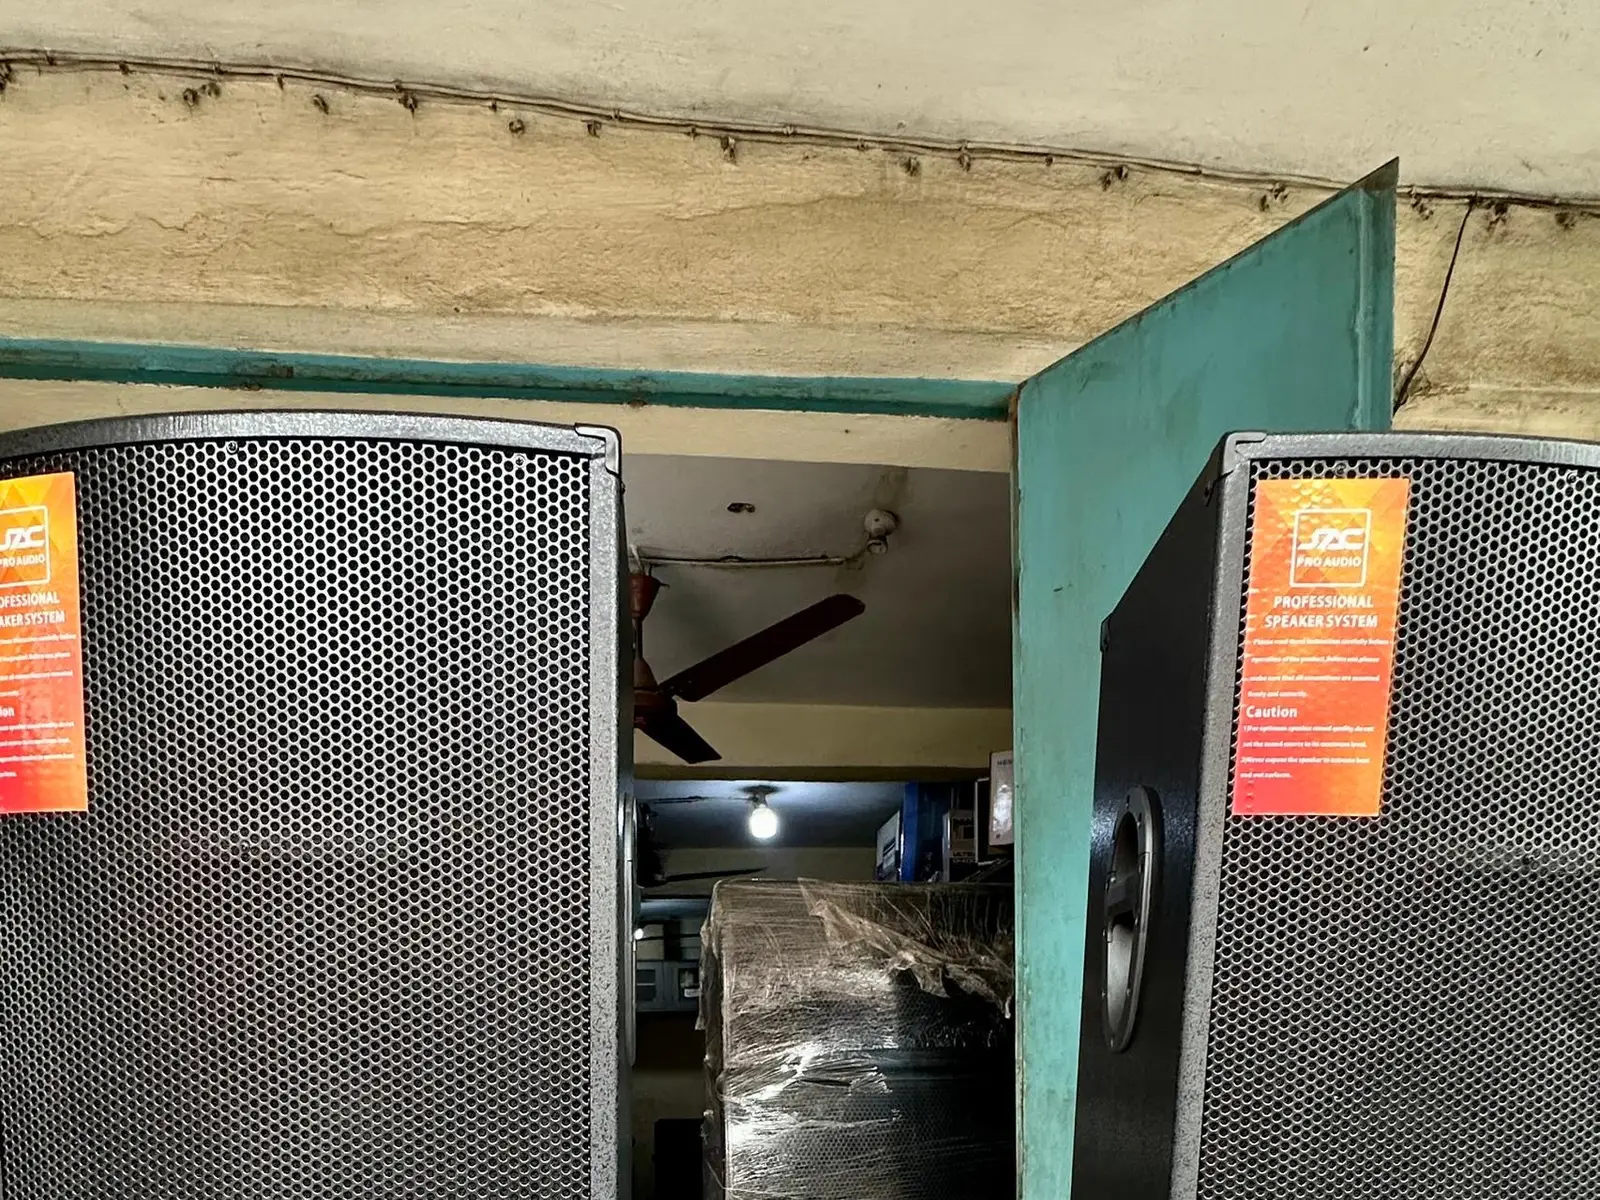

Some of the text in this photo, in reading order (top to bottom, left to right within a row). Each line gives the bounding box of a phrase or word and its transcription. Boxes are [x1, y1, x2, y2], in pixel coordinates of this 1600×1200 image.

[16, 554, 45, 566] AUDIO
[1296, 556, 1362, 567] PRO AUDIO
[1273, 595, 1374, 609] PROFESSIONAL
[24, 610, 65, 626] SYSTEM
[1264, 614, 1378, 629] SPEAKER SYSTEM
[1246, 705, 1298, 718] Caution
